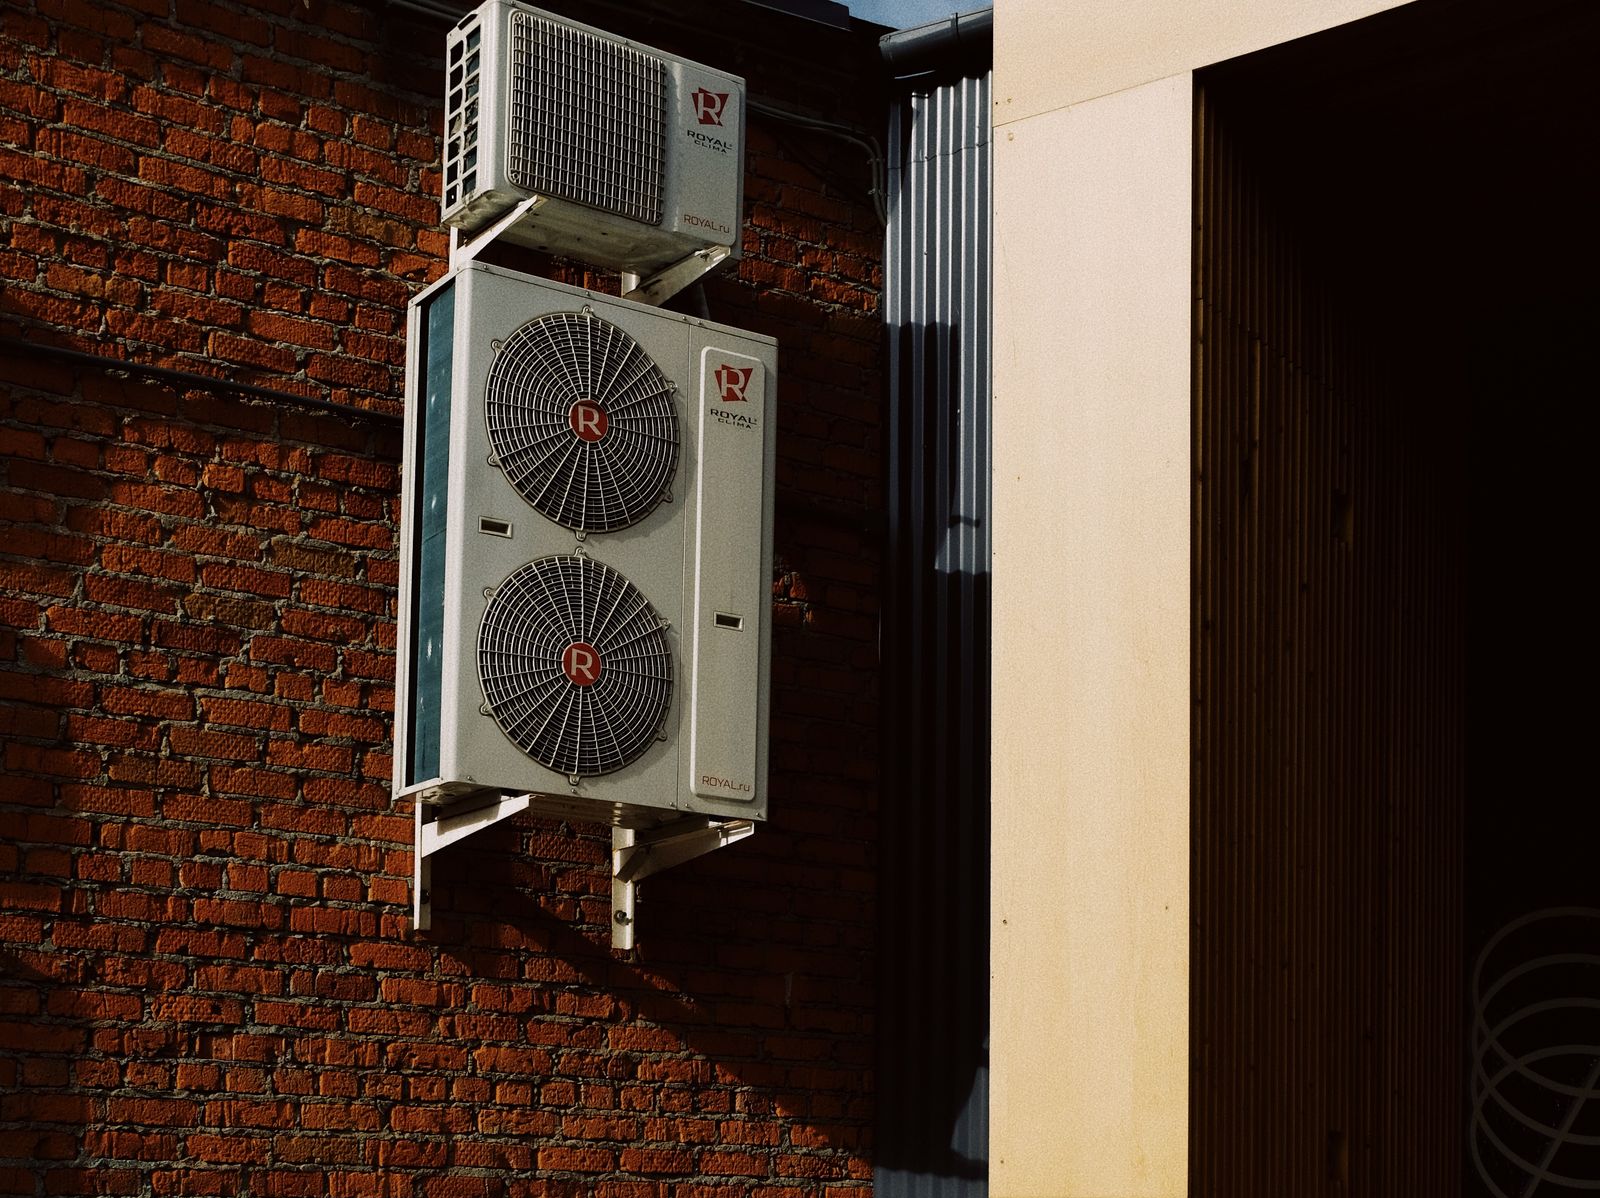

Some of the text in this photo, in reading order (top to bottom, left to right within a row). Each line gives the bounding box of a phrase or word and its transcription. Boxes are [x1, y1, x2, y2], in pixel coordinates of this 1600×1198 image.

[687, 129, 732, 150] ROYAL
[694, 140, 727, 154] CLIMA
[684, 214, 730, 234] ROYAL.ru
[578, 404, 602, 436] R
[710, 408, 757, 426] ROYAL
[717, 418, 752, 430] CLIMA
[570, 647, 595, 680] R
[702, 775, 751, 792] ROYAL.ru
